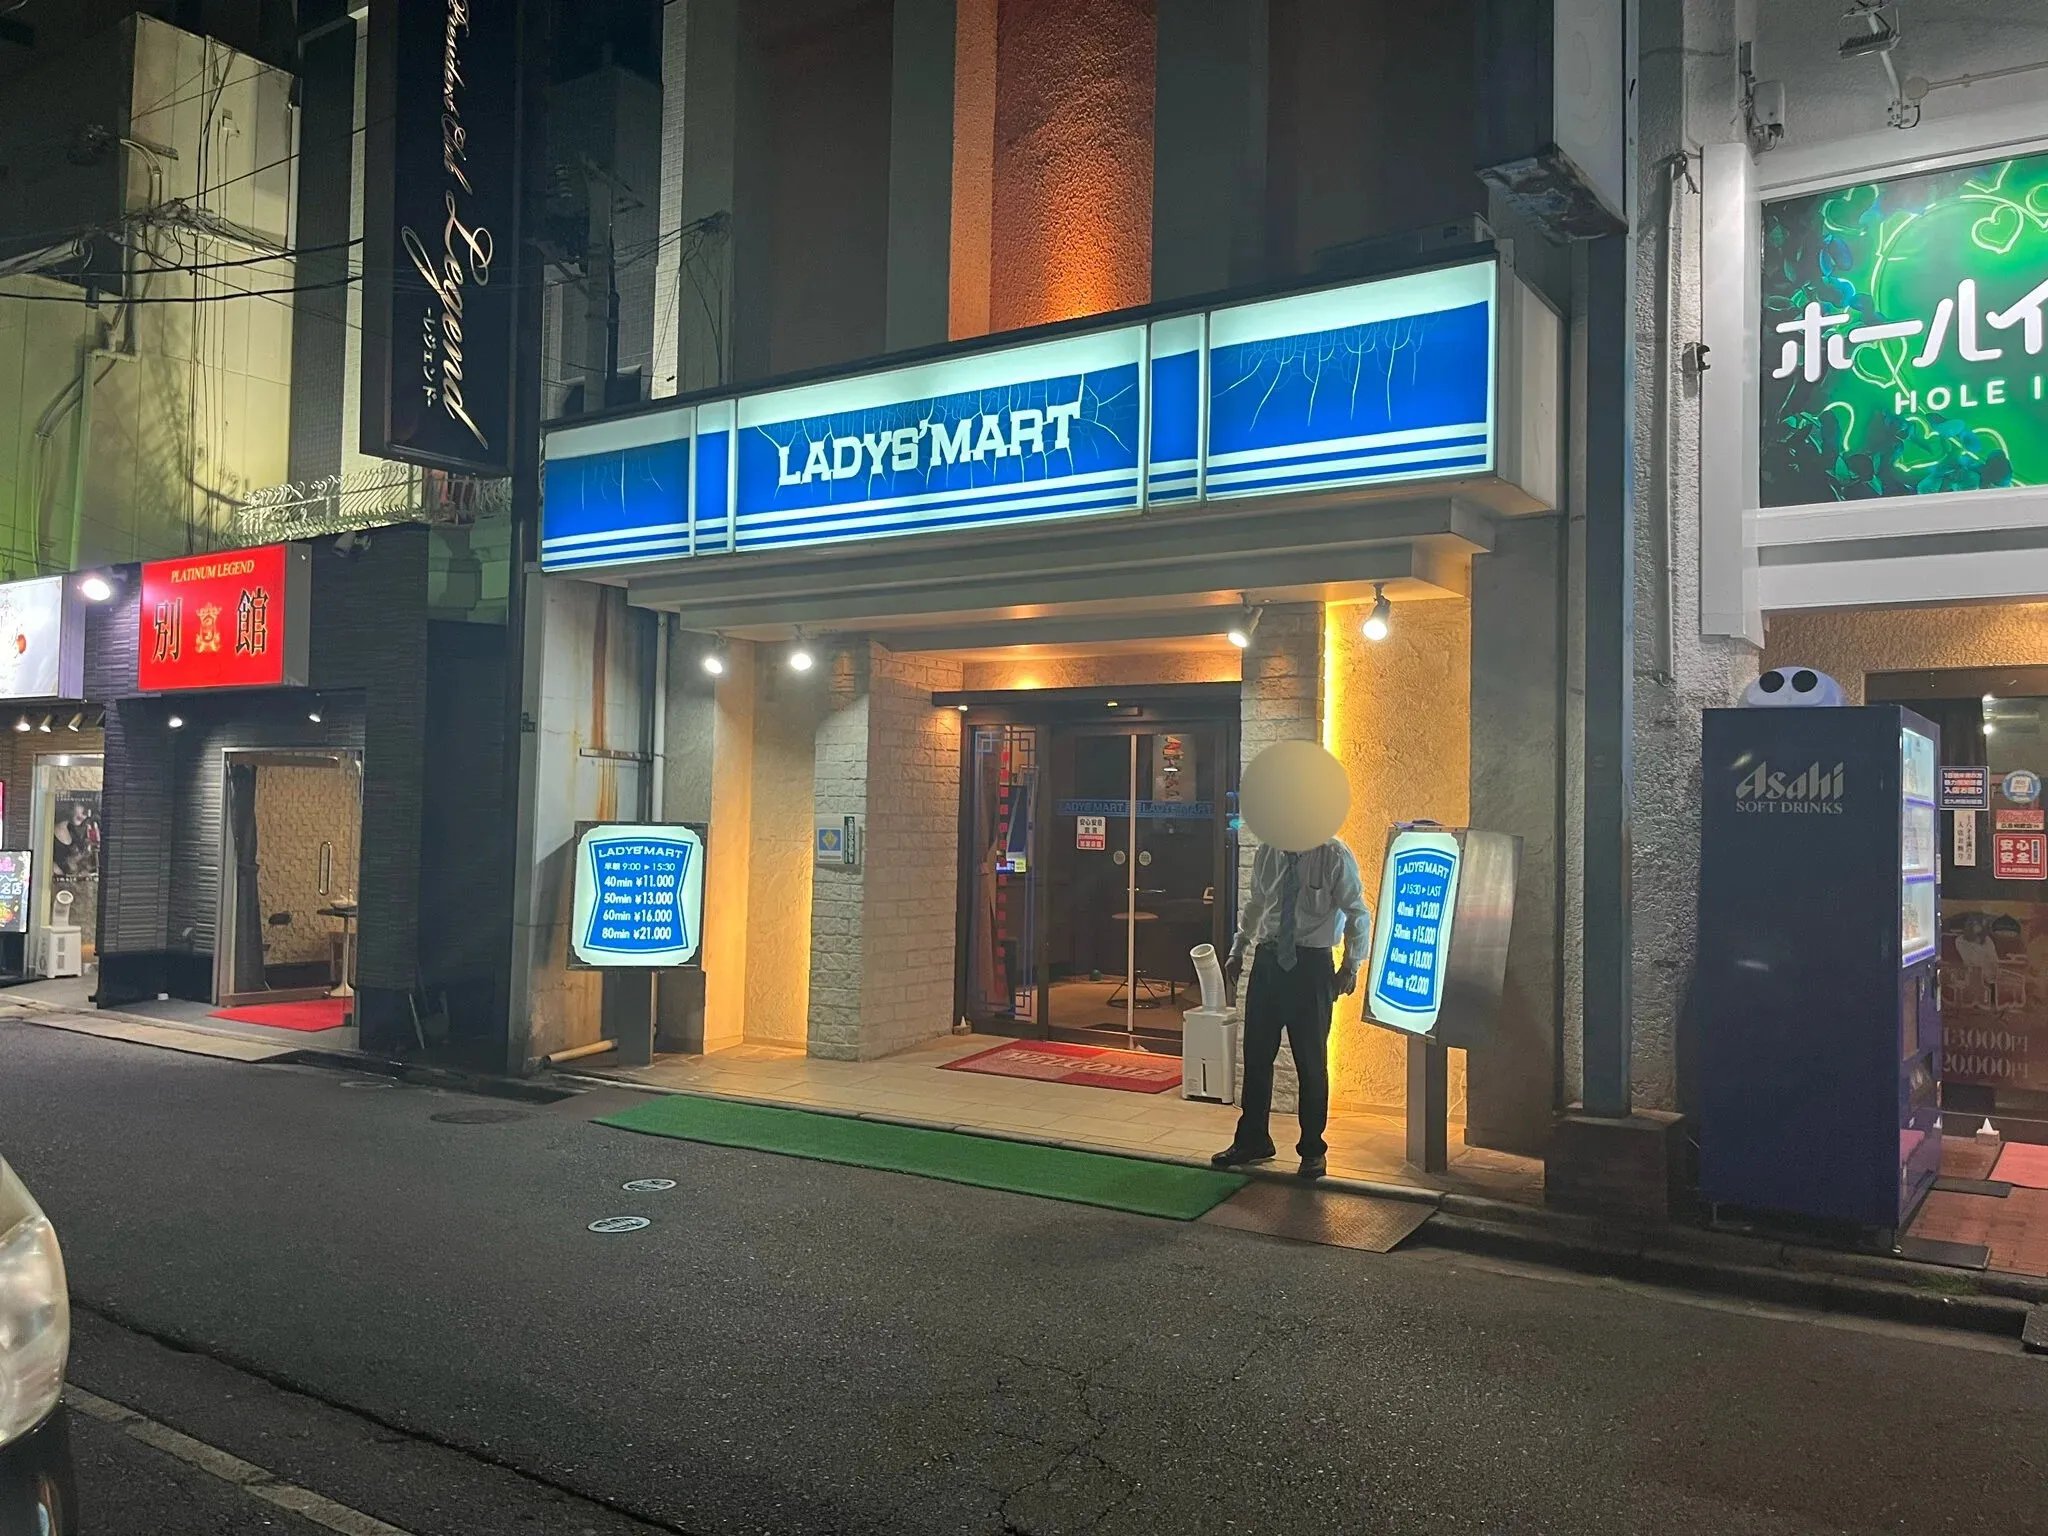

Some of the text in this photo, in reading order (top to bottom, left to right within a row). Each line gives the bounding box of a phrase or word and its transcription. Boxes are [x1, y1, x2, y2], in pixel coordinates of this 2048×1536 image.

[402, 190, 493, 449] Legend
[1894, 380, 2006, 415] HOLE
[171, 559, 255, 583] PLATINUM LEGEND
[1736, 760, 1844, 800] Asahi
[1736, 801, 1843, 814] SOFT DRINKS
[2000, 839, 2030, 851] 安心
[2000, 852, 2030, 864] 安全
[622, 862, 641, 871] 9:00
[653, 862, 675, 871] 15:30
[604, 876, 633, 887] 40min
[1427, 885, 1441, 897] LAST
[604, 892, 632, 904] 50min
[603, 909, 631, 920] 60min
[602, 927, 630, 939] 80min
[1001, 1051, 1165, 1077] WELCOME
